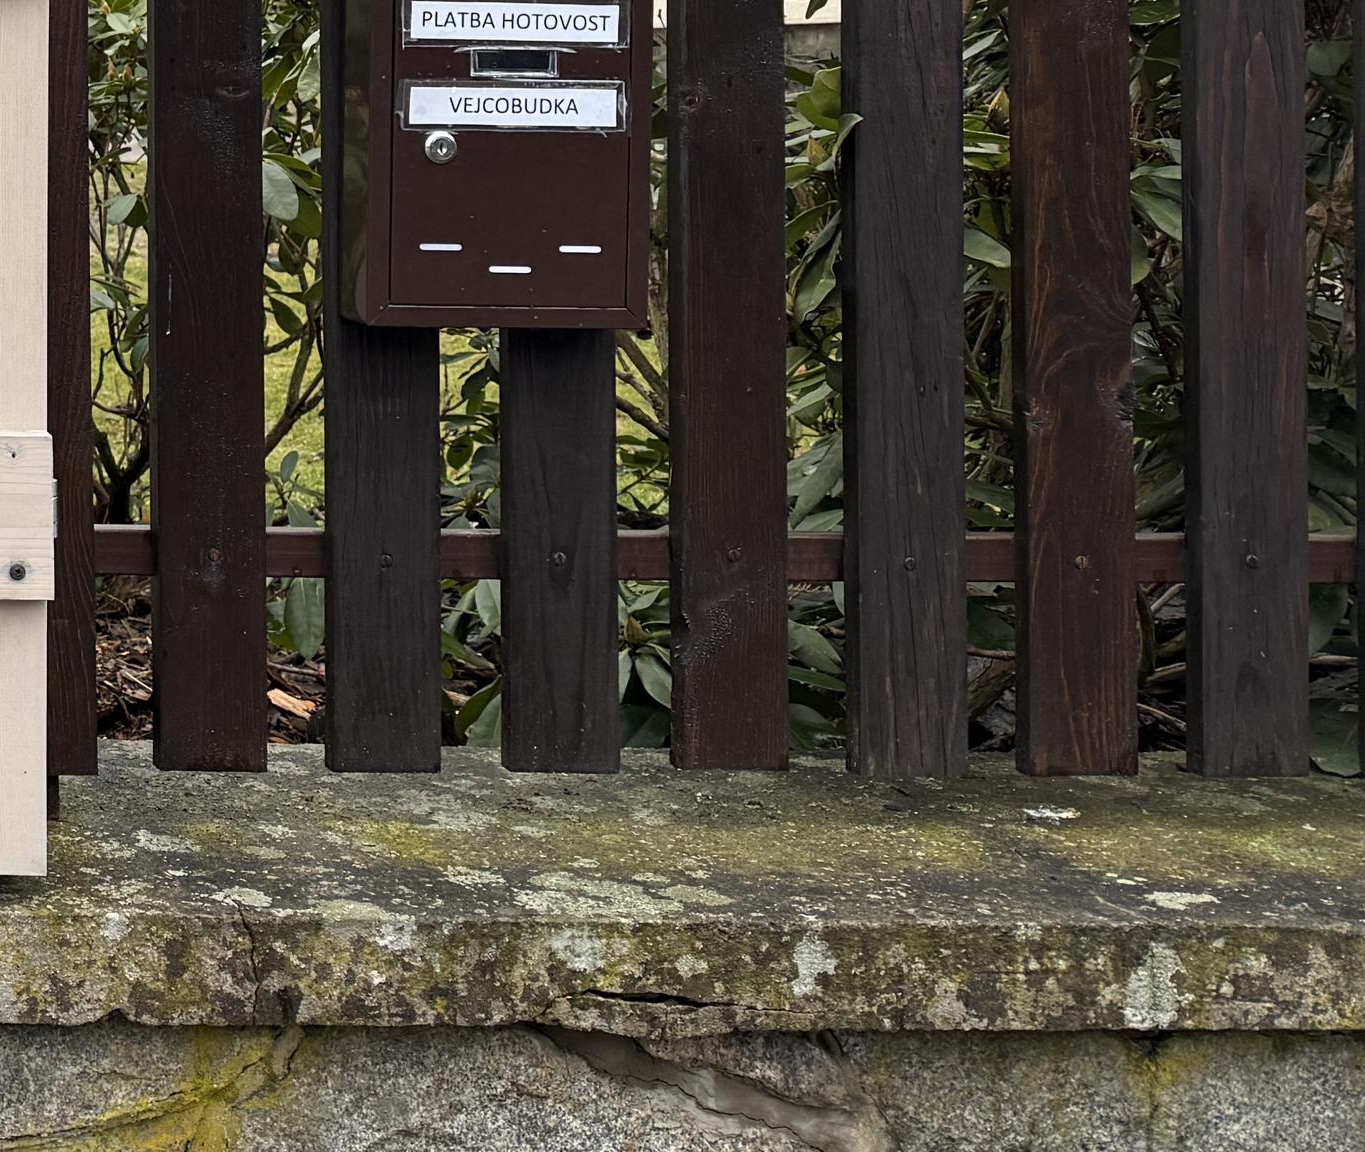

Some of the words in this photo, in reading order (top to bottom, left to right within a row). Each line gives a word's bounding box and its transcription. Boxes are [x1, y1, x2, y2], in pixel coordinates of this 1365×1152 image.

[423, 11, 495, 28] PLATBA
[503, 13, 610, 31] HOTOVOST
[450, 97, 578, 114] VEJCOBUDKA
